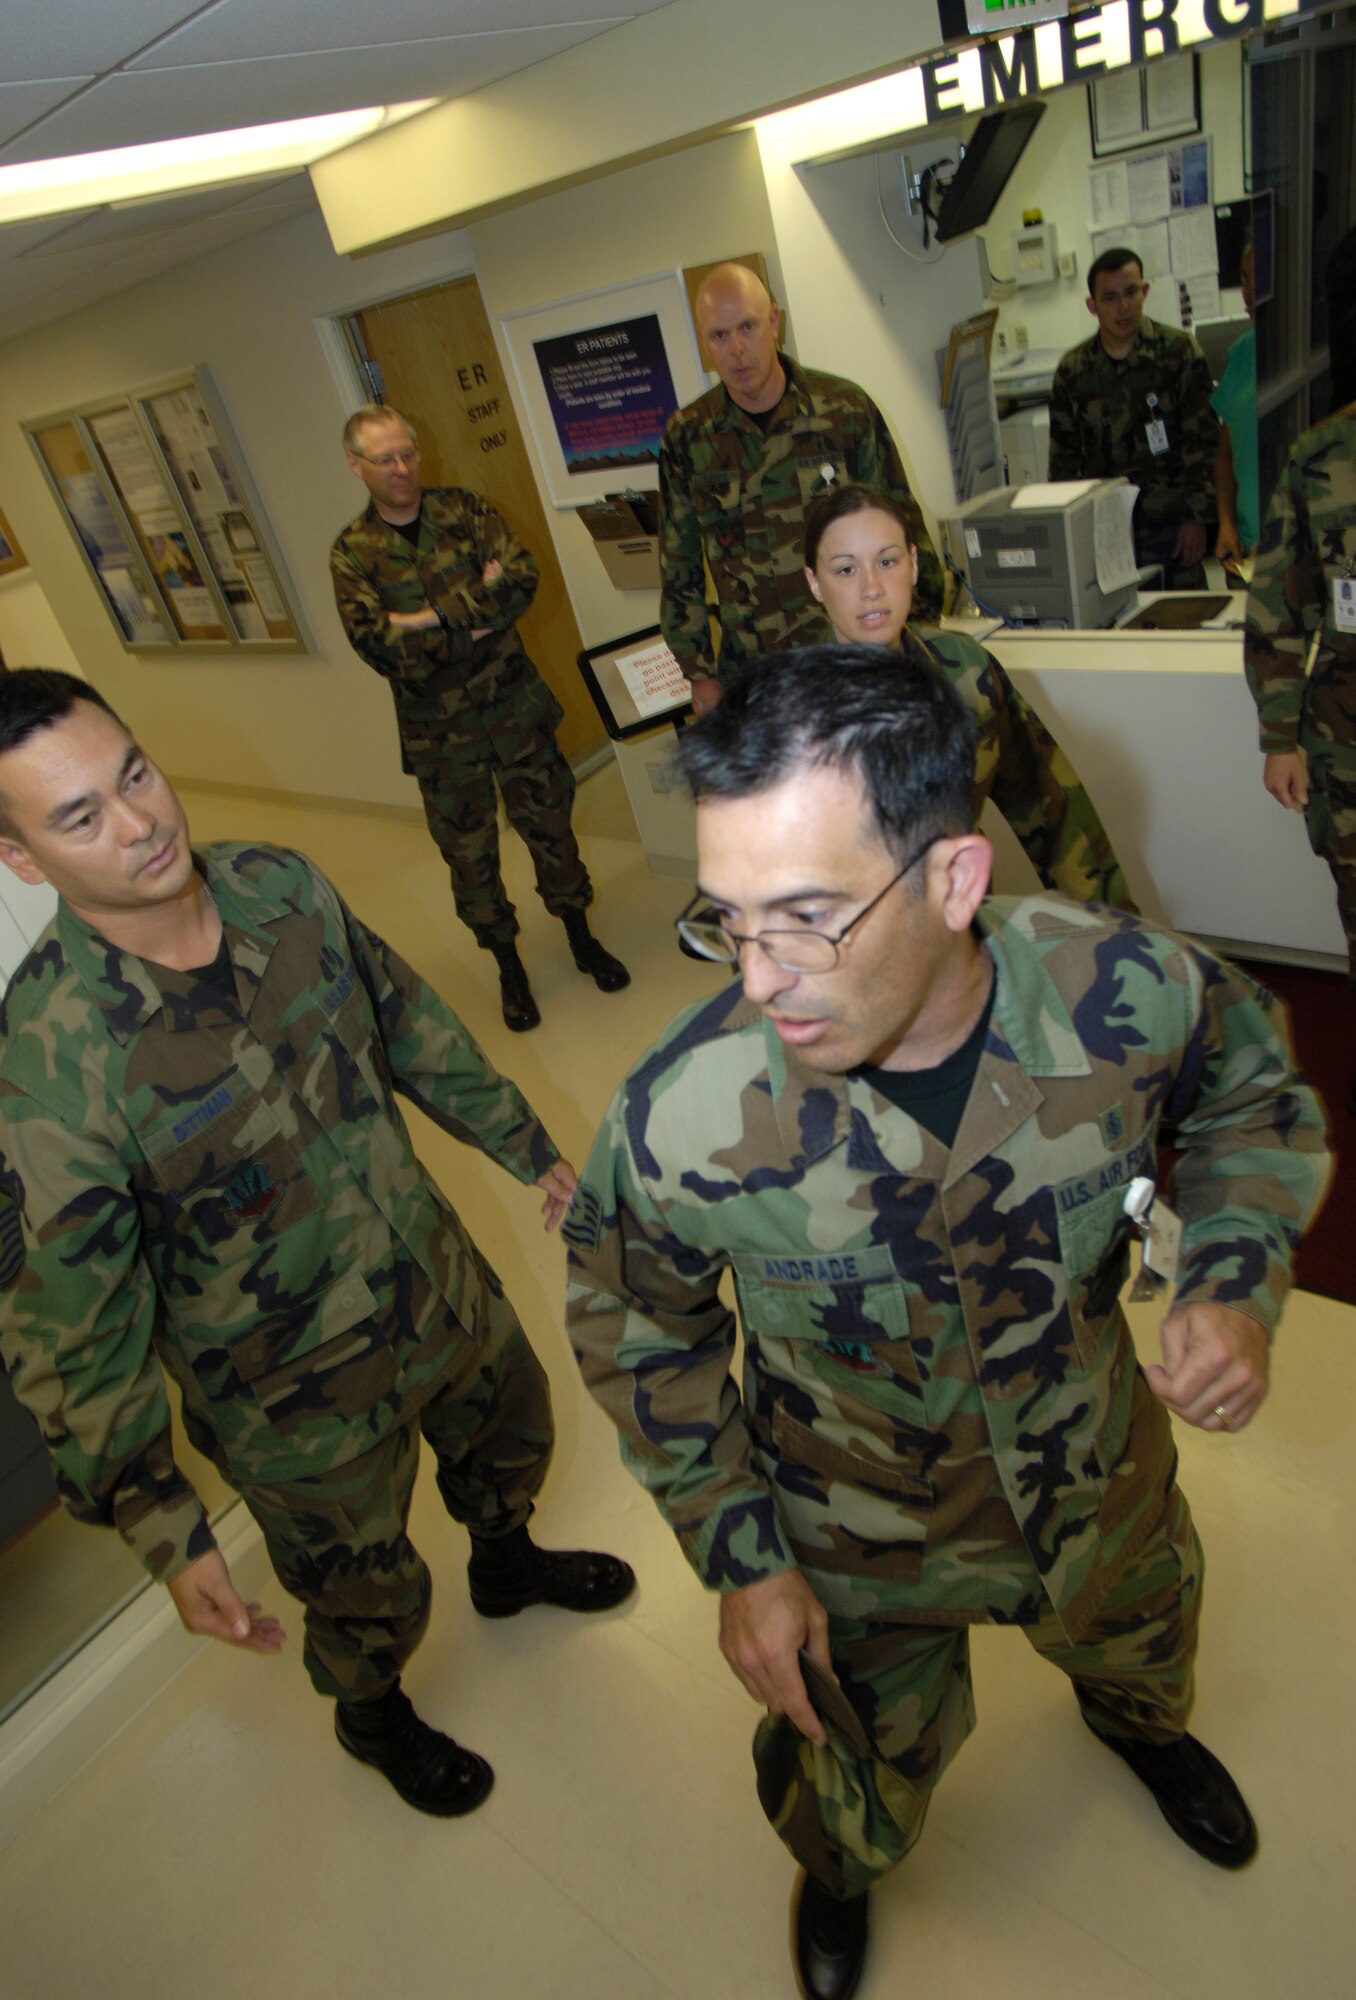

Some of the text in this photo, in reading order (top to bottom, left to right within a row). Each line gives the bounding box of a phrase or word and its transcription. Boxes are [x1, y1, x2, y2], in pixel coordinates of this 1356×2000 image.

[922, 0, 1340, 122] EMERG
[576, 334, 629, 354] ER PATIENTS
[457, 363, 488, 391] ER
[467, 398, 500, 424] STAFF
[480, 428, 508, 454] ONLY
[633, 654, 662, 669] Please
[642, 659, 674, 677] go past
[644, 667, 682, 687] point wit
[647, 677, 686, 696] checking
[670, 684, 689, 697] desk
[172, 1087, 233, 1143] DITTMAN
[1060, 1182, 1093, 1212] U.S.
[1099, 1161, 1124, 1194] AIR
[764, 1256, 859, 1281] ANDRADE
